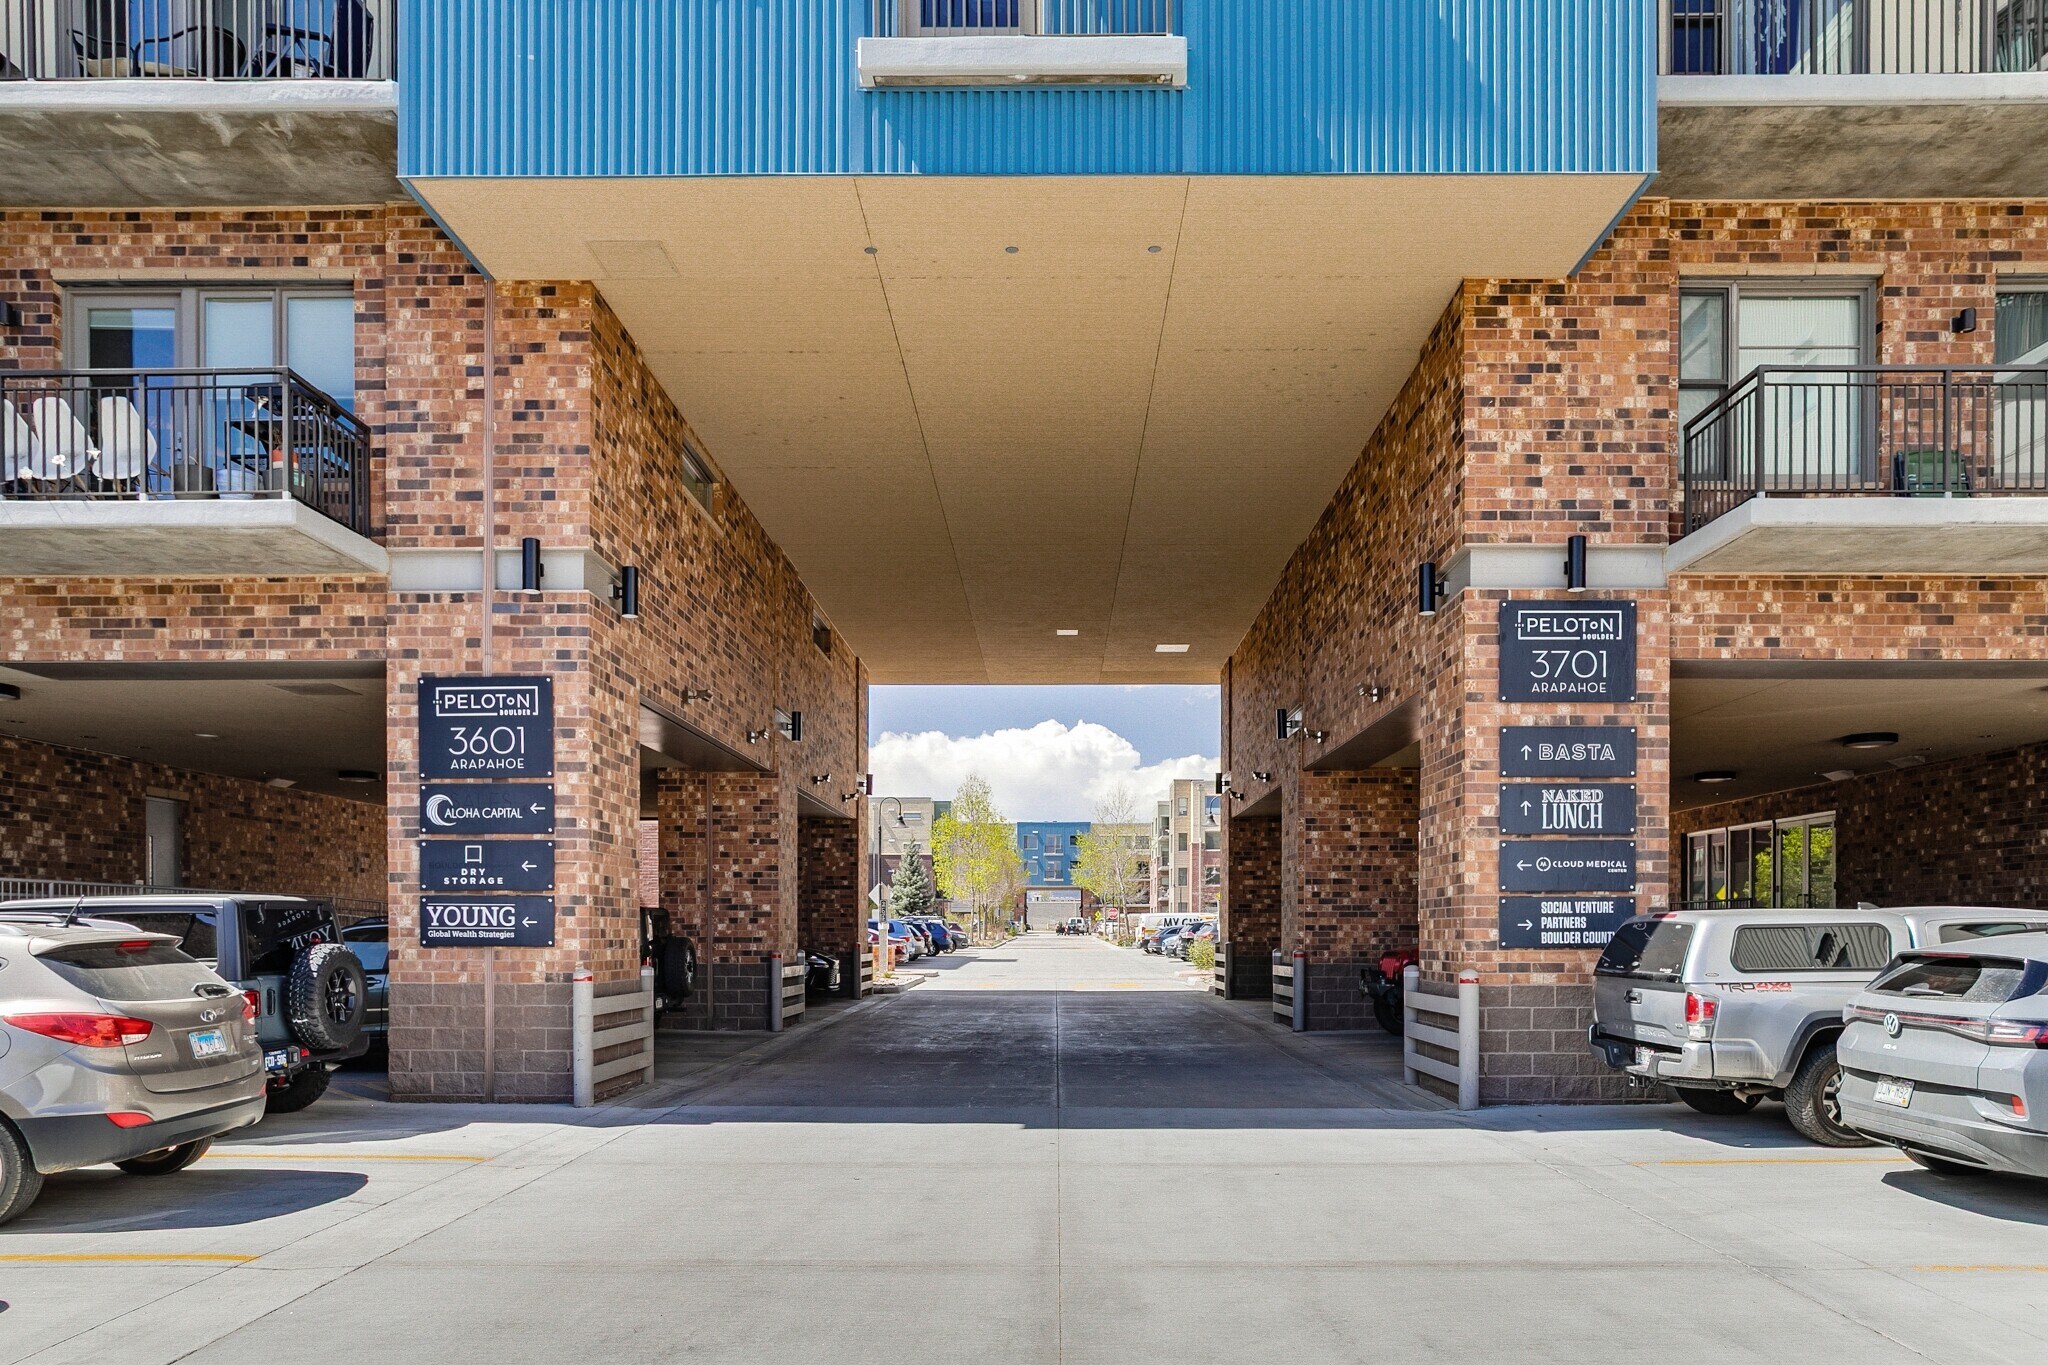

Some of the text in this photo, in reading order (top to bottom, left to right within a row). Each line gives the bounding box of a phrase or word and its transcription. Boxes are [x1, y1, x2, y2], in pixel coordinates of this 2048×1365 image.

[1527, 618, 1613, 632] PELOTON
[1530, 650, 1607, 678] 3701
[1531, 682, 1607, 693] ARAPAHOE
[444, 693, 530, 709] PELOTON
[449, 726, 525, 755] 3601
[1538, 743, 1616, 761] BASTA
[450, 758, 525, 770] ARAPAHOE
[1541, 789, 1604, 803] NAKED
[444, 807, 523, 819] ALOHA CAPITAL
[1541, 803, 1603, 829] LUNCH
[1552, 860, 1628, 868] CLOUD MEDICAL
[461, 868, 486, 876] DRY
[443, 877, 504, 885] STORAGE
[1541, 901, 1614, 914] SOCIAL VENTURE
[426, 906, 516, 927] YOUNG
[1541, 916, 1587, 929] PARTNERS
[428, 930, 515, 940] Global Wealth Strategies
[1541, 931, 1615, 944] BOULDER COUNT
[1715, 982, 1756, 993] TRD
